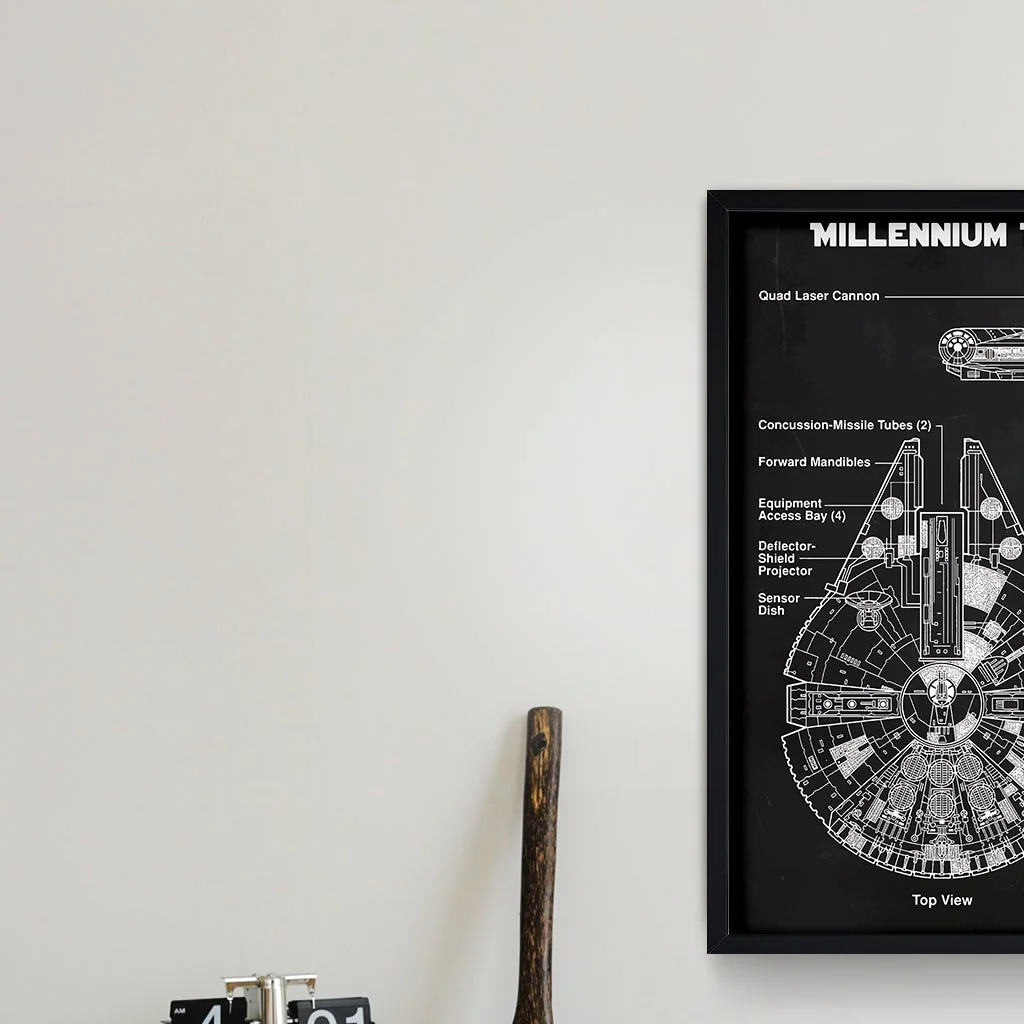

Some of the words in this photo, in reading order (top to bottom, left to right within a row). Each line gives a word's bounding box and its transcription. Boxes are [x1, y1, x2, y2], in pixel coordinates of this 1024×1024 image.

[809, 222, 1007, 248] MILLENNIUM
[758, 289, 792, 301] Quad
[795, 290, 830, 301] Laser
[832, 290, 880, 302] Cannon
[758, 419, 875, 431] Concussion-Missile
[877, 419, 914, 431] Tubes
[916, 419, 932, 433] (2)
[758, 456, 807, 467] Forward
[810, 456, 871, 468] Mandibles
[758, 498, 823, 513] Equipment
[758, 510, 803, 521] Access
[804, 510, 828, 524] Bay
[830, 510, 846, 524] (4)
[758, 540, 816, 552] Deflector-
[757, 552, 795, 564] Shield
[758, 565, 813, 579] Projector
[757, 592, 801, 603] Sensor
[758, 604, 785, 616] Dish
[911, 893, 938, 909] Top
[940, 894, 973, 906] View
[174, 1007, 187, 1015] AM
